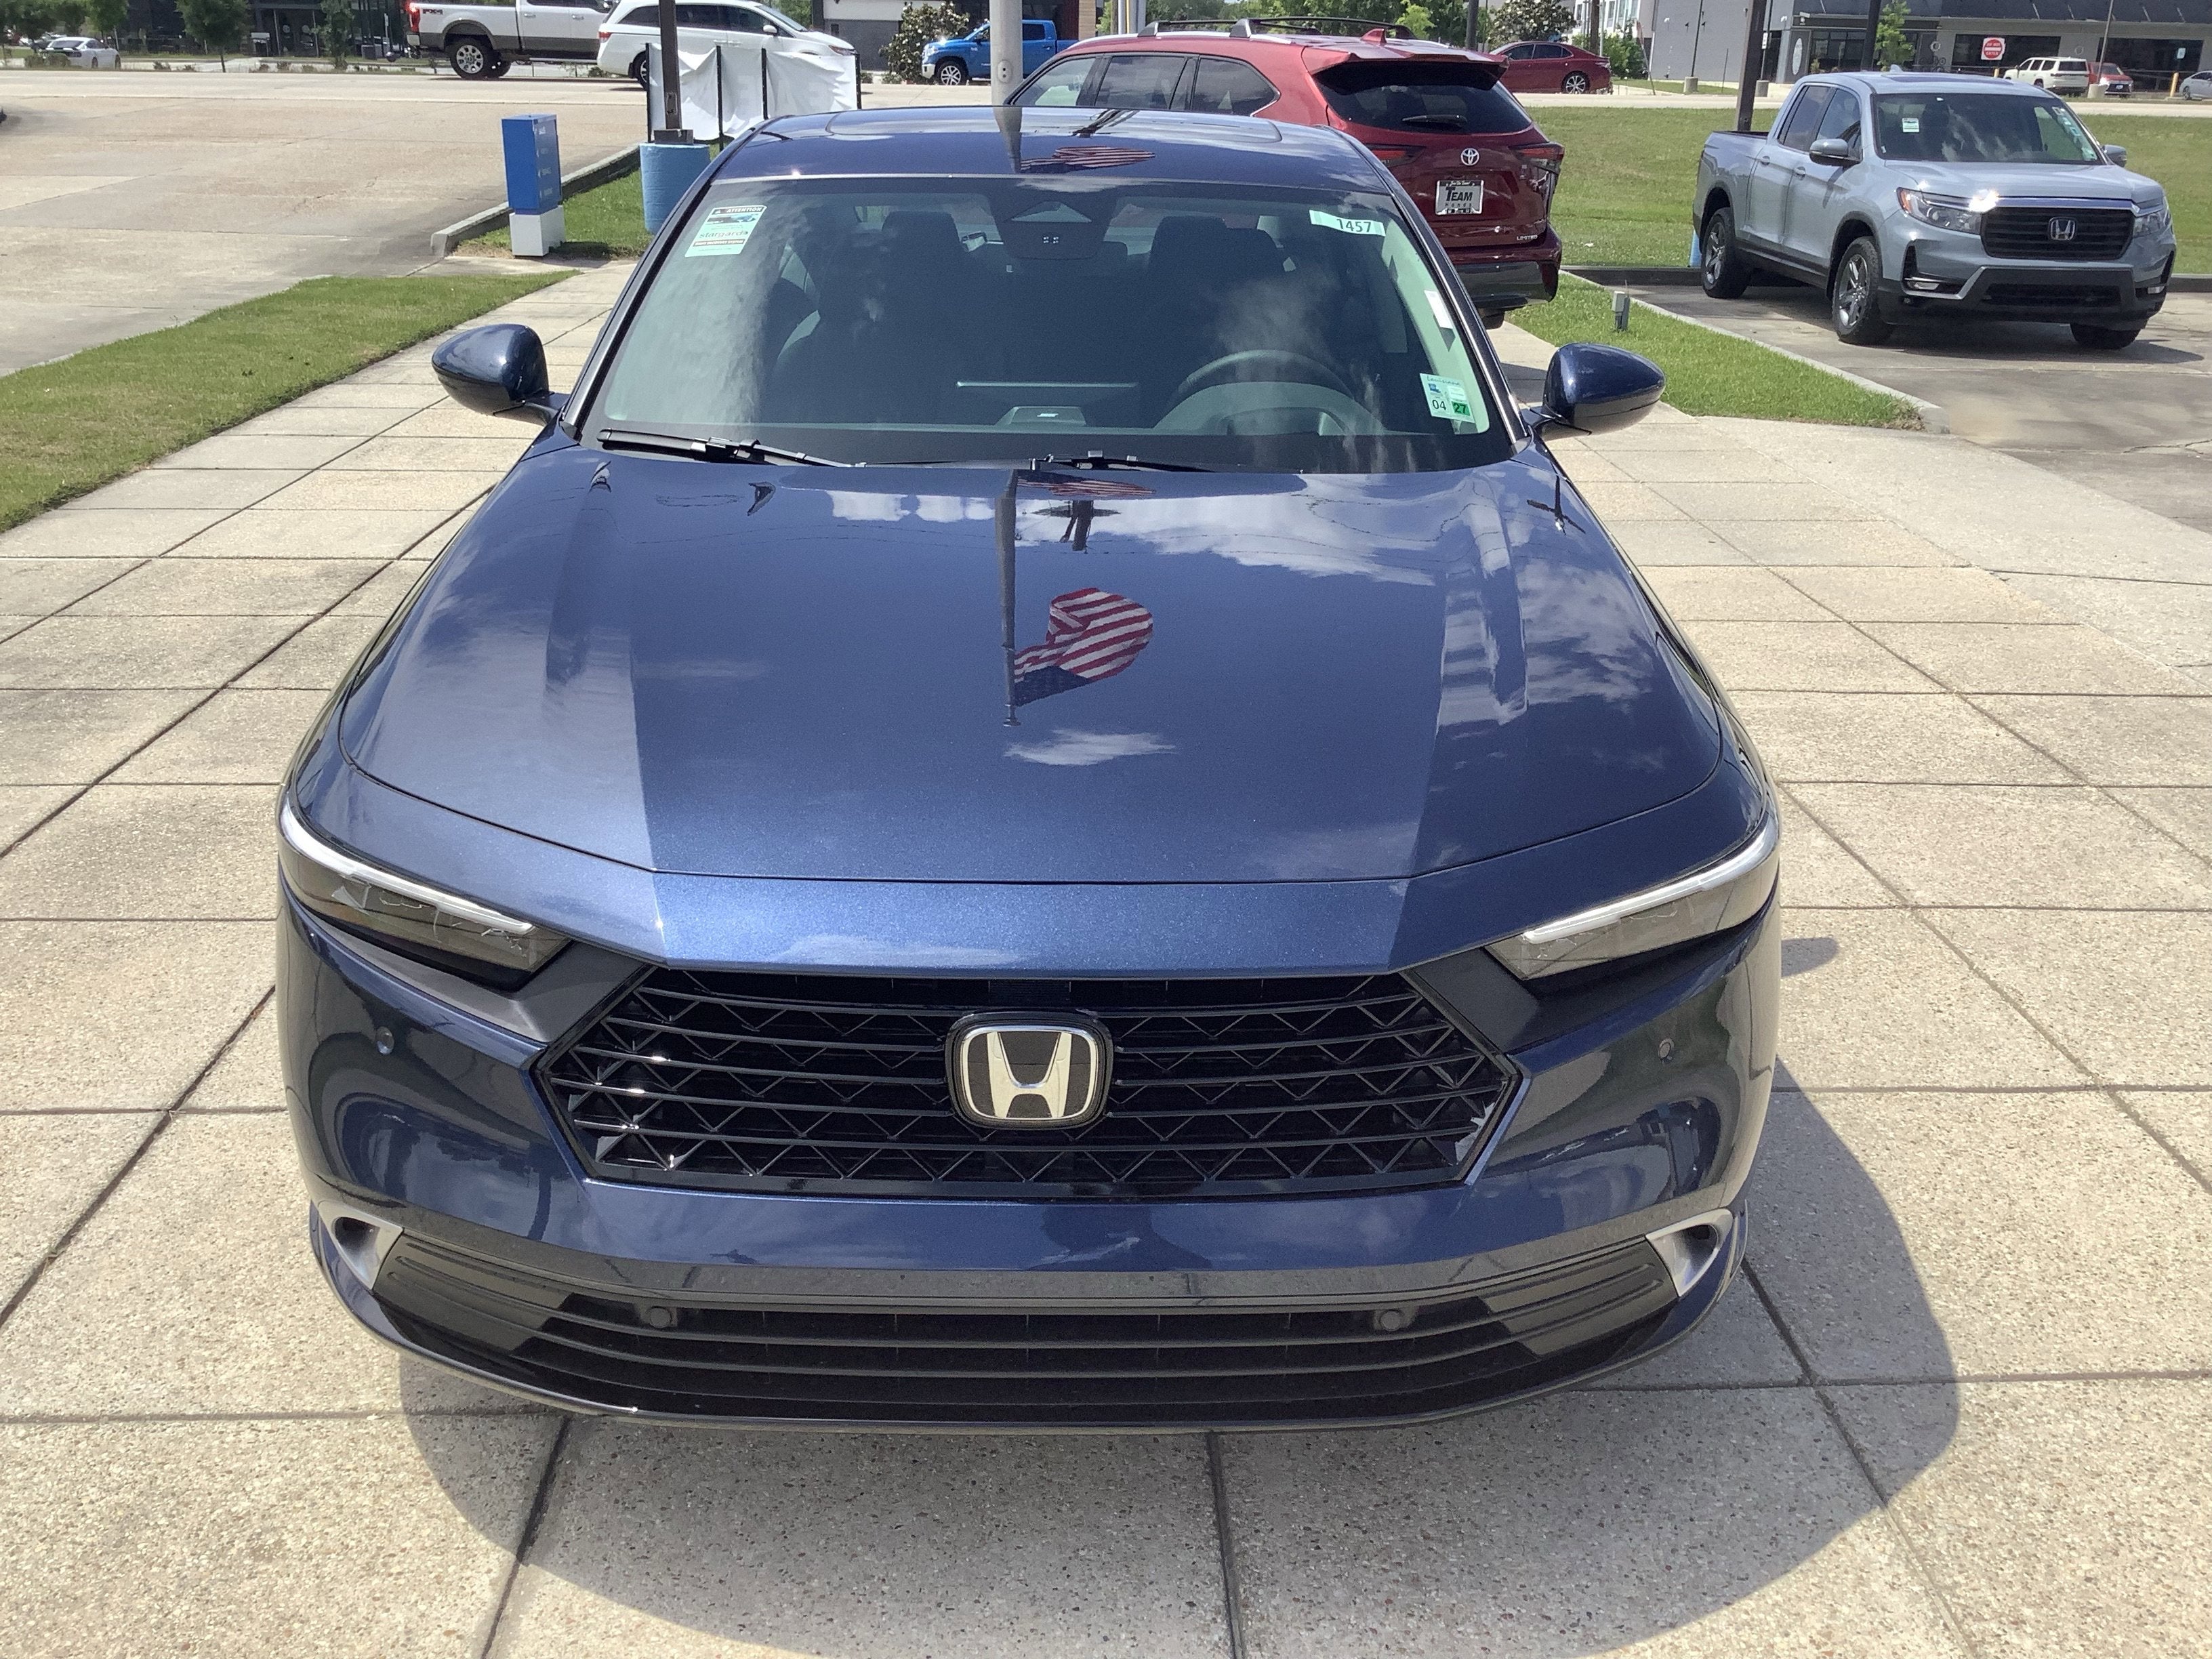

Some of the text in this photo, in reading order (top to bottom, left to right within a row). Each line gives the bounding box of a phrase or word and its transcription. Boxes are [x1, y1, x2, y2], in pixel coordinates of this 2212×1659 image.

[1336, 218, 1372, 232] 1457
[1432, 399, 1468, 414] 04 27
